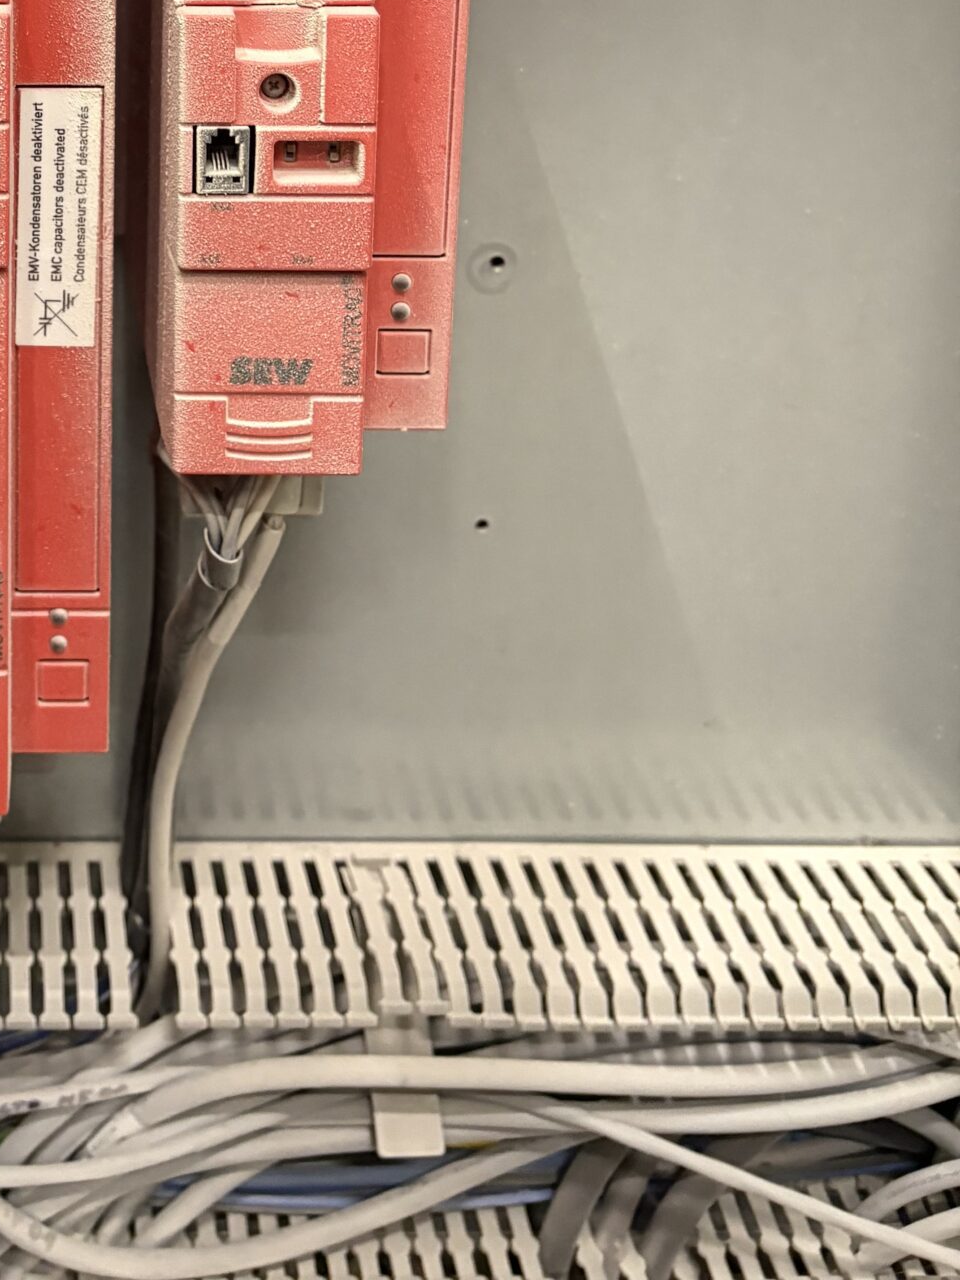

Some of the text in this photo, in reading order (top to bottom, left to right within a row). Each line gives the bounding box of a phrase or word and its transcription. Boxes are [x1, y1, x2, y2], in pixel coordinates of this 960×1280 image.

[28, 102, 44, 282] EMV-Kondensatoren deaktiviert
[51, 128, 66, 282] EMC capacitors deactivated
[73, 106, 89, 283] Condensateurs CEM désactivés
[229, 356, 313, 385] SEW
